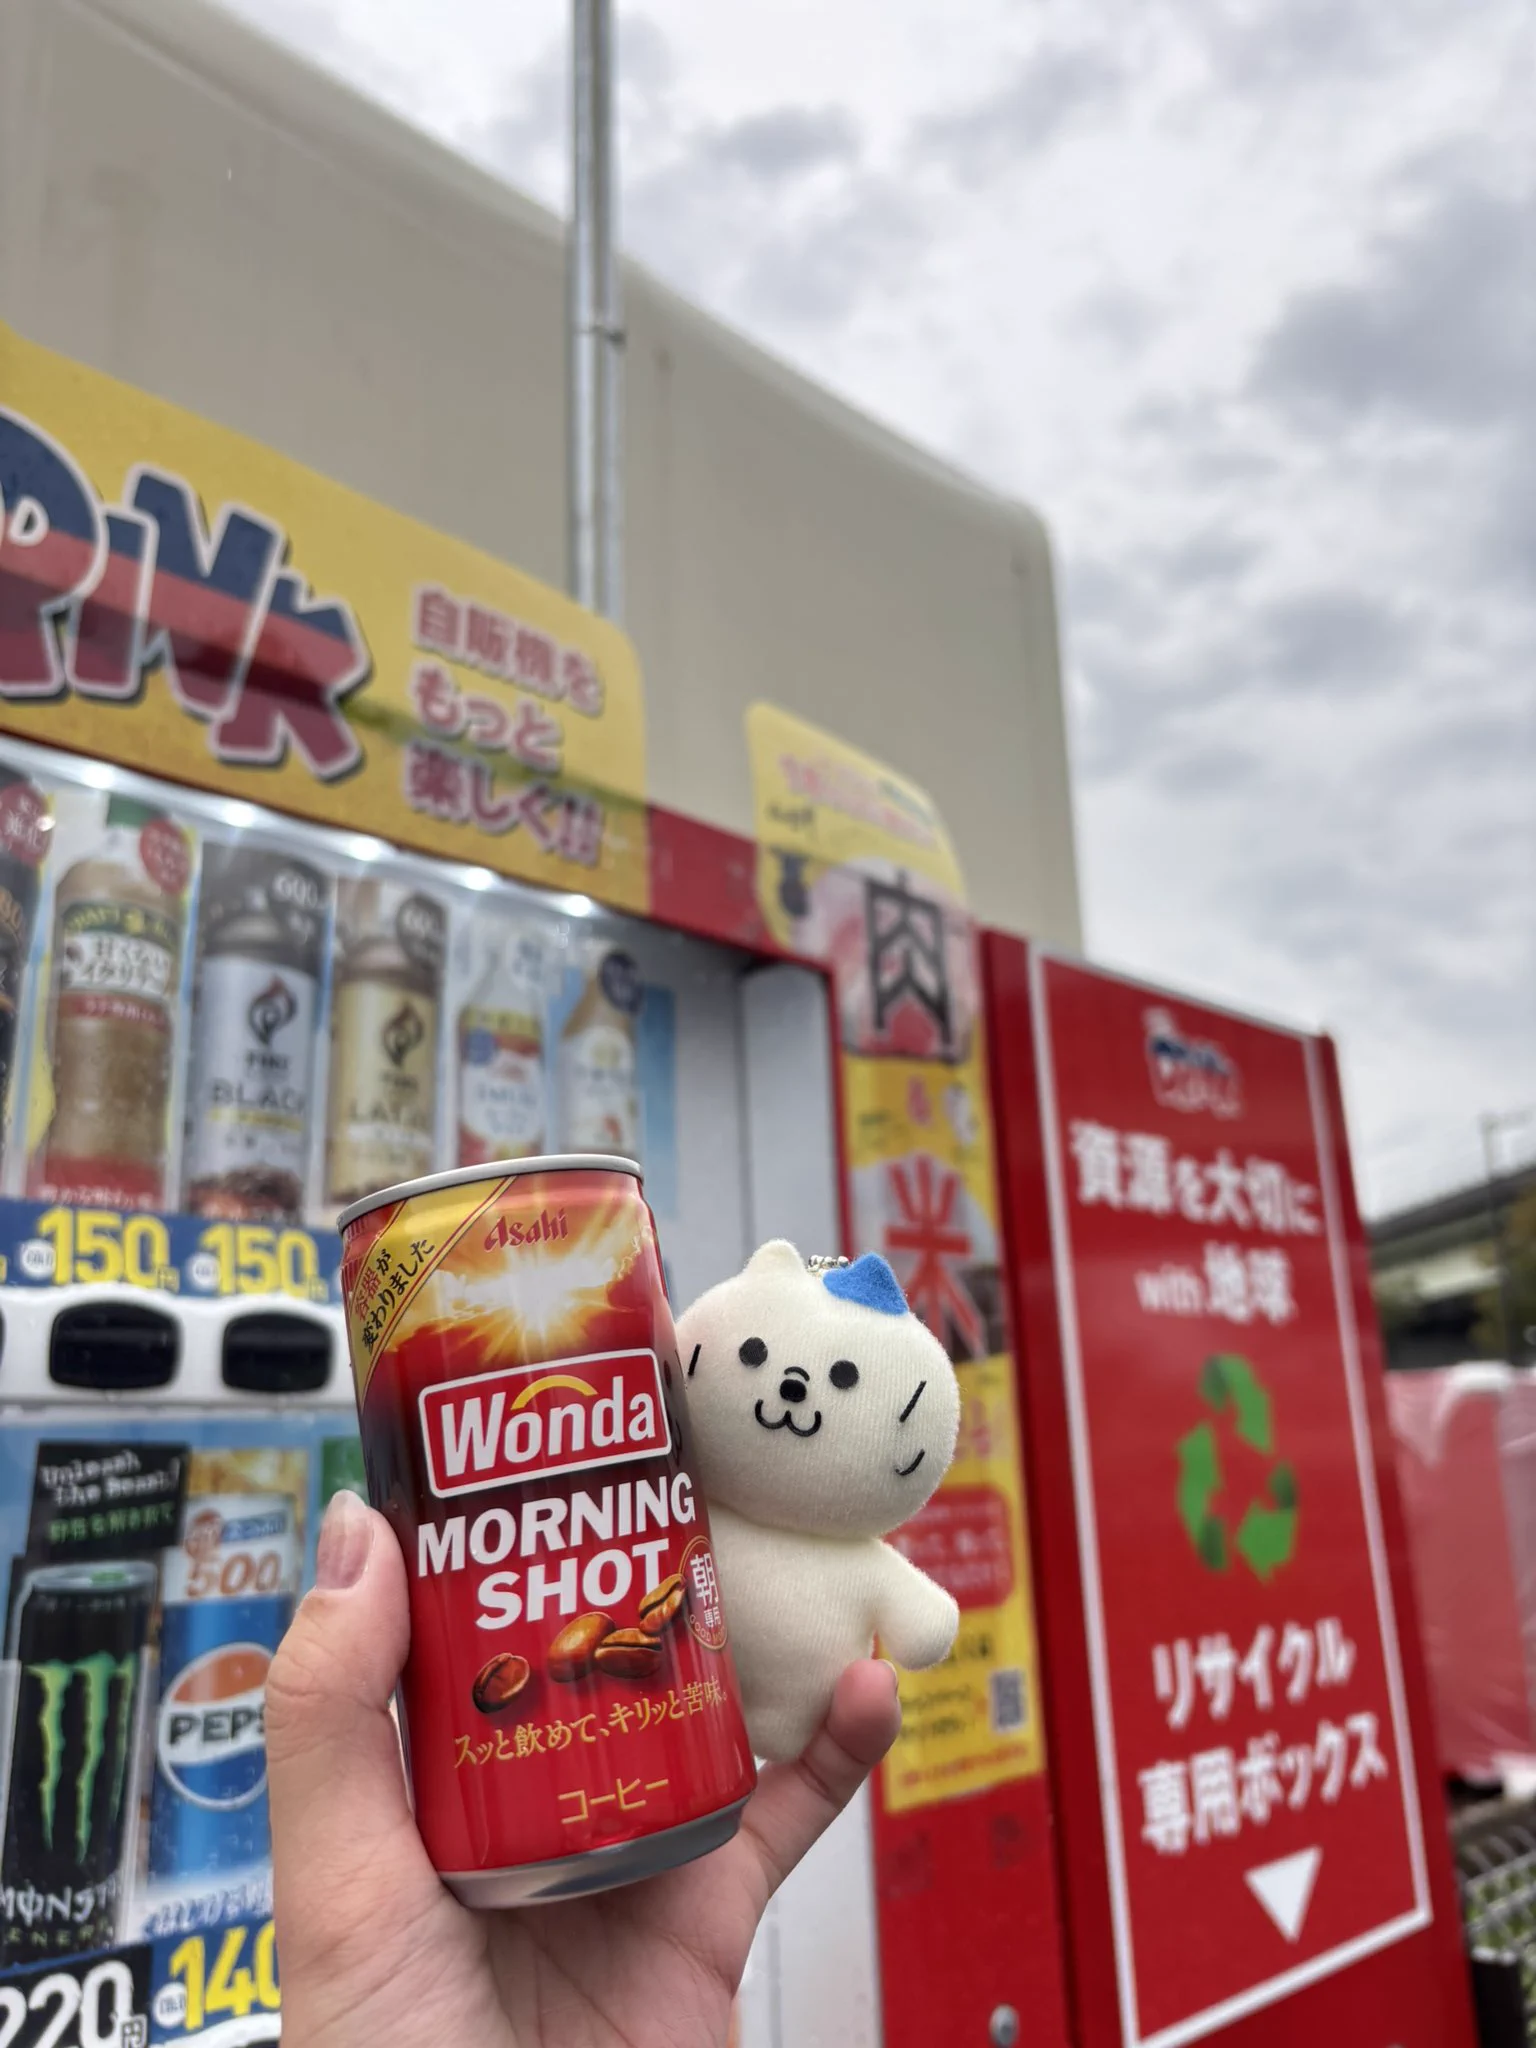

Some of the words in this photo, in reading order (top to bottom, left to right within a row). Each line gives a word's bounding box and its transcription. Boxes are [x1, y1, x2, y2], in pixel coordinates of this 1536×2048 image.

[411, 663, 563, 775] もっと
[483, 1208, 568, 1252] Asahi
[362, 1239, 435, 1356] 変わりました
[1134, 1263, 1202, 1313] with
[1204, 1240, 1297, 1327] 地球
[441, 1376, 656, 1479] Wonda
[417, 1472, 697, 1578] MORNING
[474, 1538, 670, 1631] SHOT
[690, 1552, 719, 1606] 朝
[1152, 1616, 1357, 1730] リサイクル
[454, 1676, 729, 1769] スッと飲めて、キリッと苦味。
[558, 1778, 669, 1825] コーヒー
[1137, 1711, 1388, 1856] 専用ボックス
